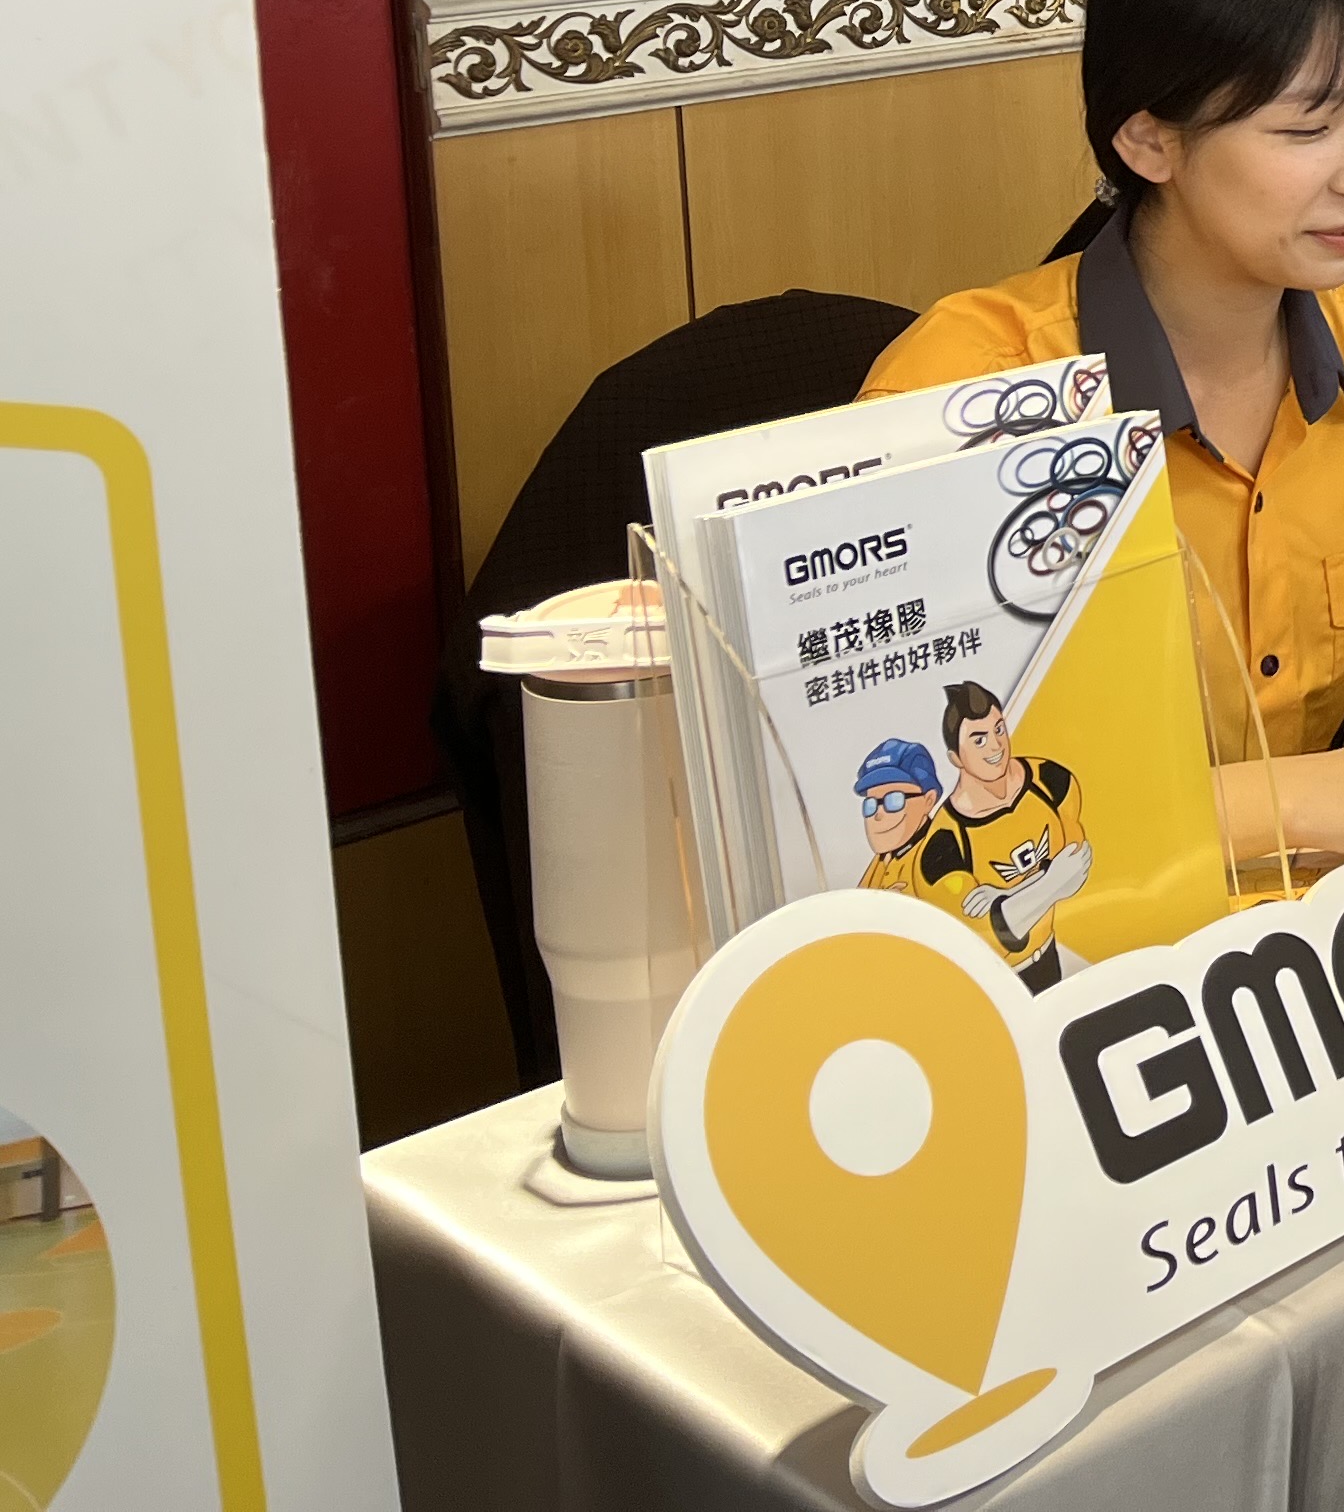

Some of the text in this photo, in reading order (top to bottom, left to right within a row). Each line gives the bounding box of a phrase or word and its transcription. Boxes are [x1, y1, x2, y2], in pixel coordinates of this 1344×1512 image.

[789, 562, 909, 605] Seals to your heart
[797, 598, 927, 668] 繼茂橡膠
[804, 628, 982, 707] 密封件的好夥伴
[1140, 1162, 1317, 1293] Seals
